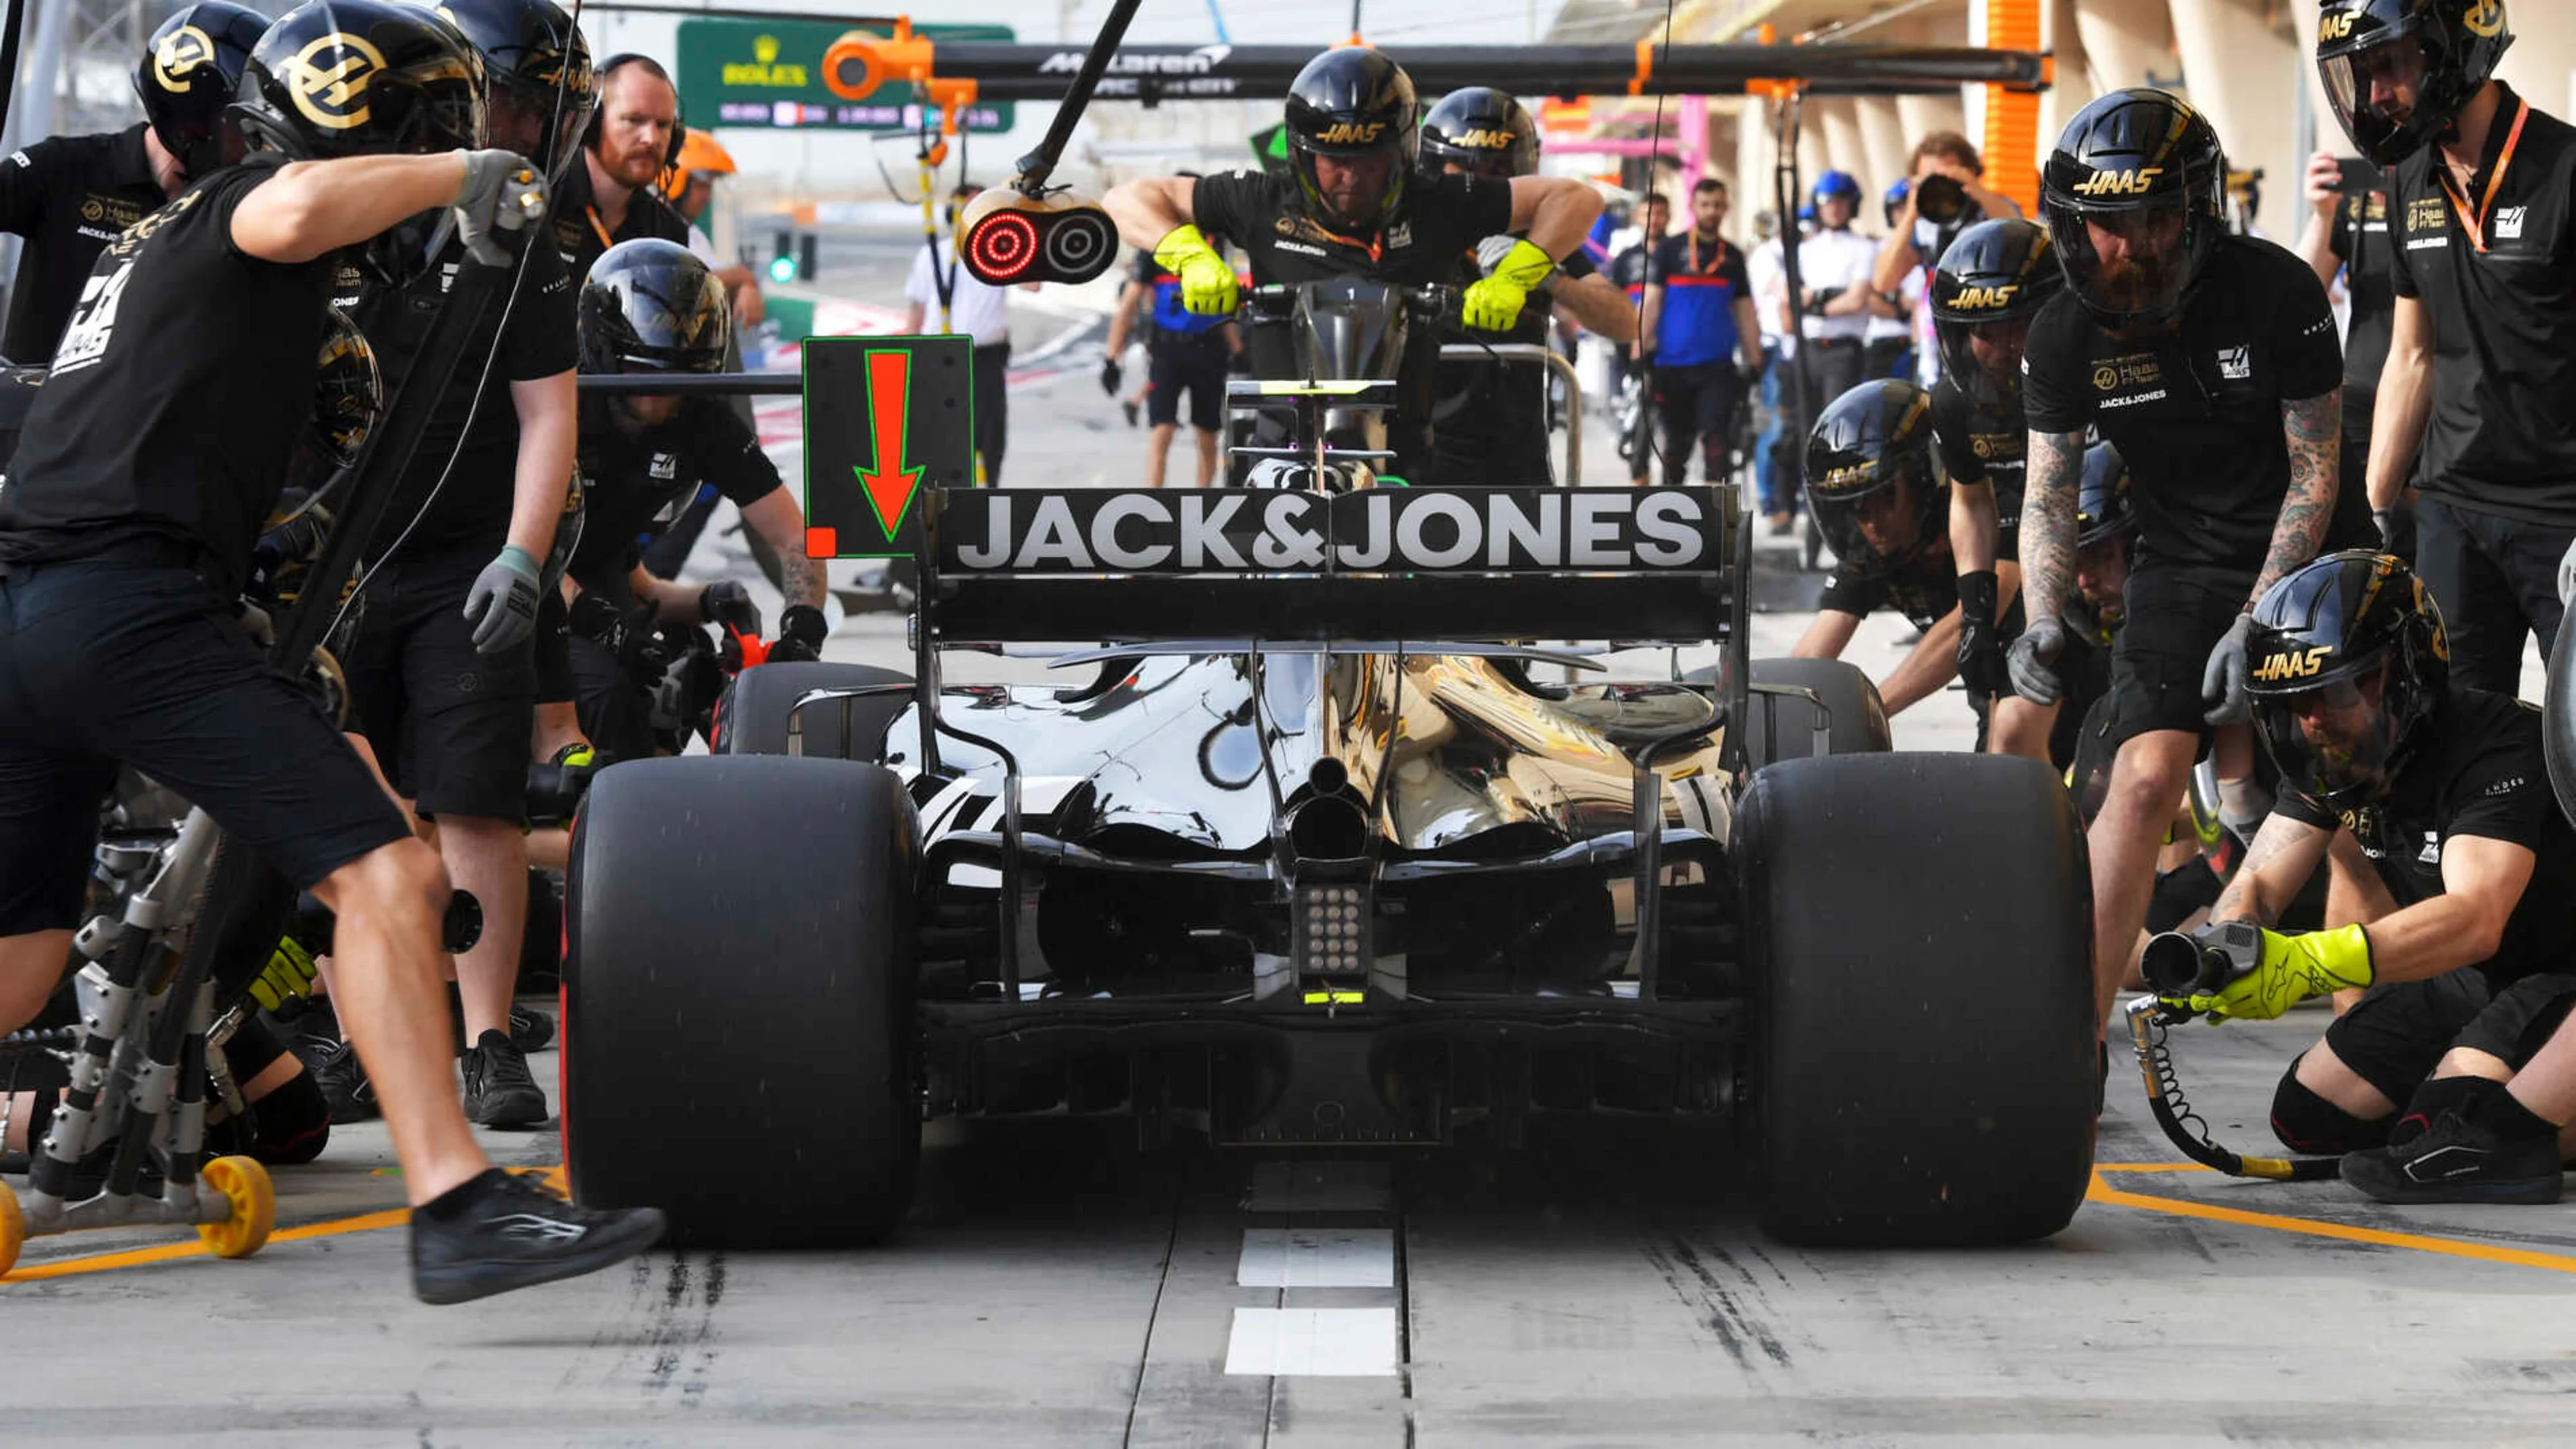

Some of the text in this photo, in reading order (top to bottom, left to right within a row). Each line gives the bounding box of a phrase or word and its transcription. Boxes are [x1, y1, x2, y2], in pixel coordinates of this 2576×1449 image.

[2318, 10, 2362, 43] AAS
[722, 63, 807, 86] ROLEX
[1316, 122, 1386, 143] HAAS
[1449, 129, 1515, 150] HAAS
[2073, 167, 2164, 196] HAAS
[77, 225, 119, 242] JACK&JO
[1948, 285, 2018, 310] HAAS
[2099, 389, 2167, 409] JACK&JONES
[957, 493, 1704, 568] JACK&JONES
[2253, 645, 2334, 682] HAAS
